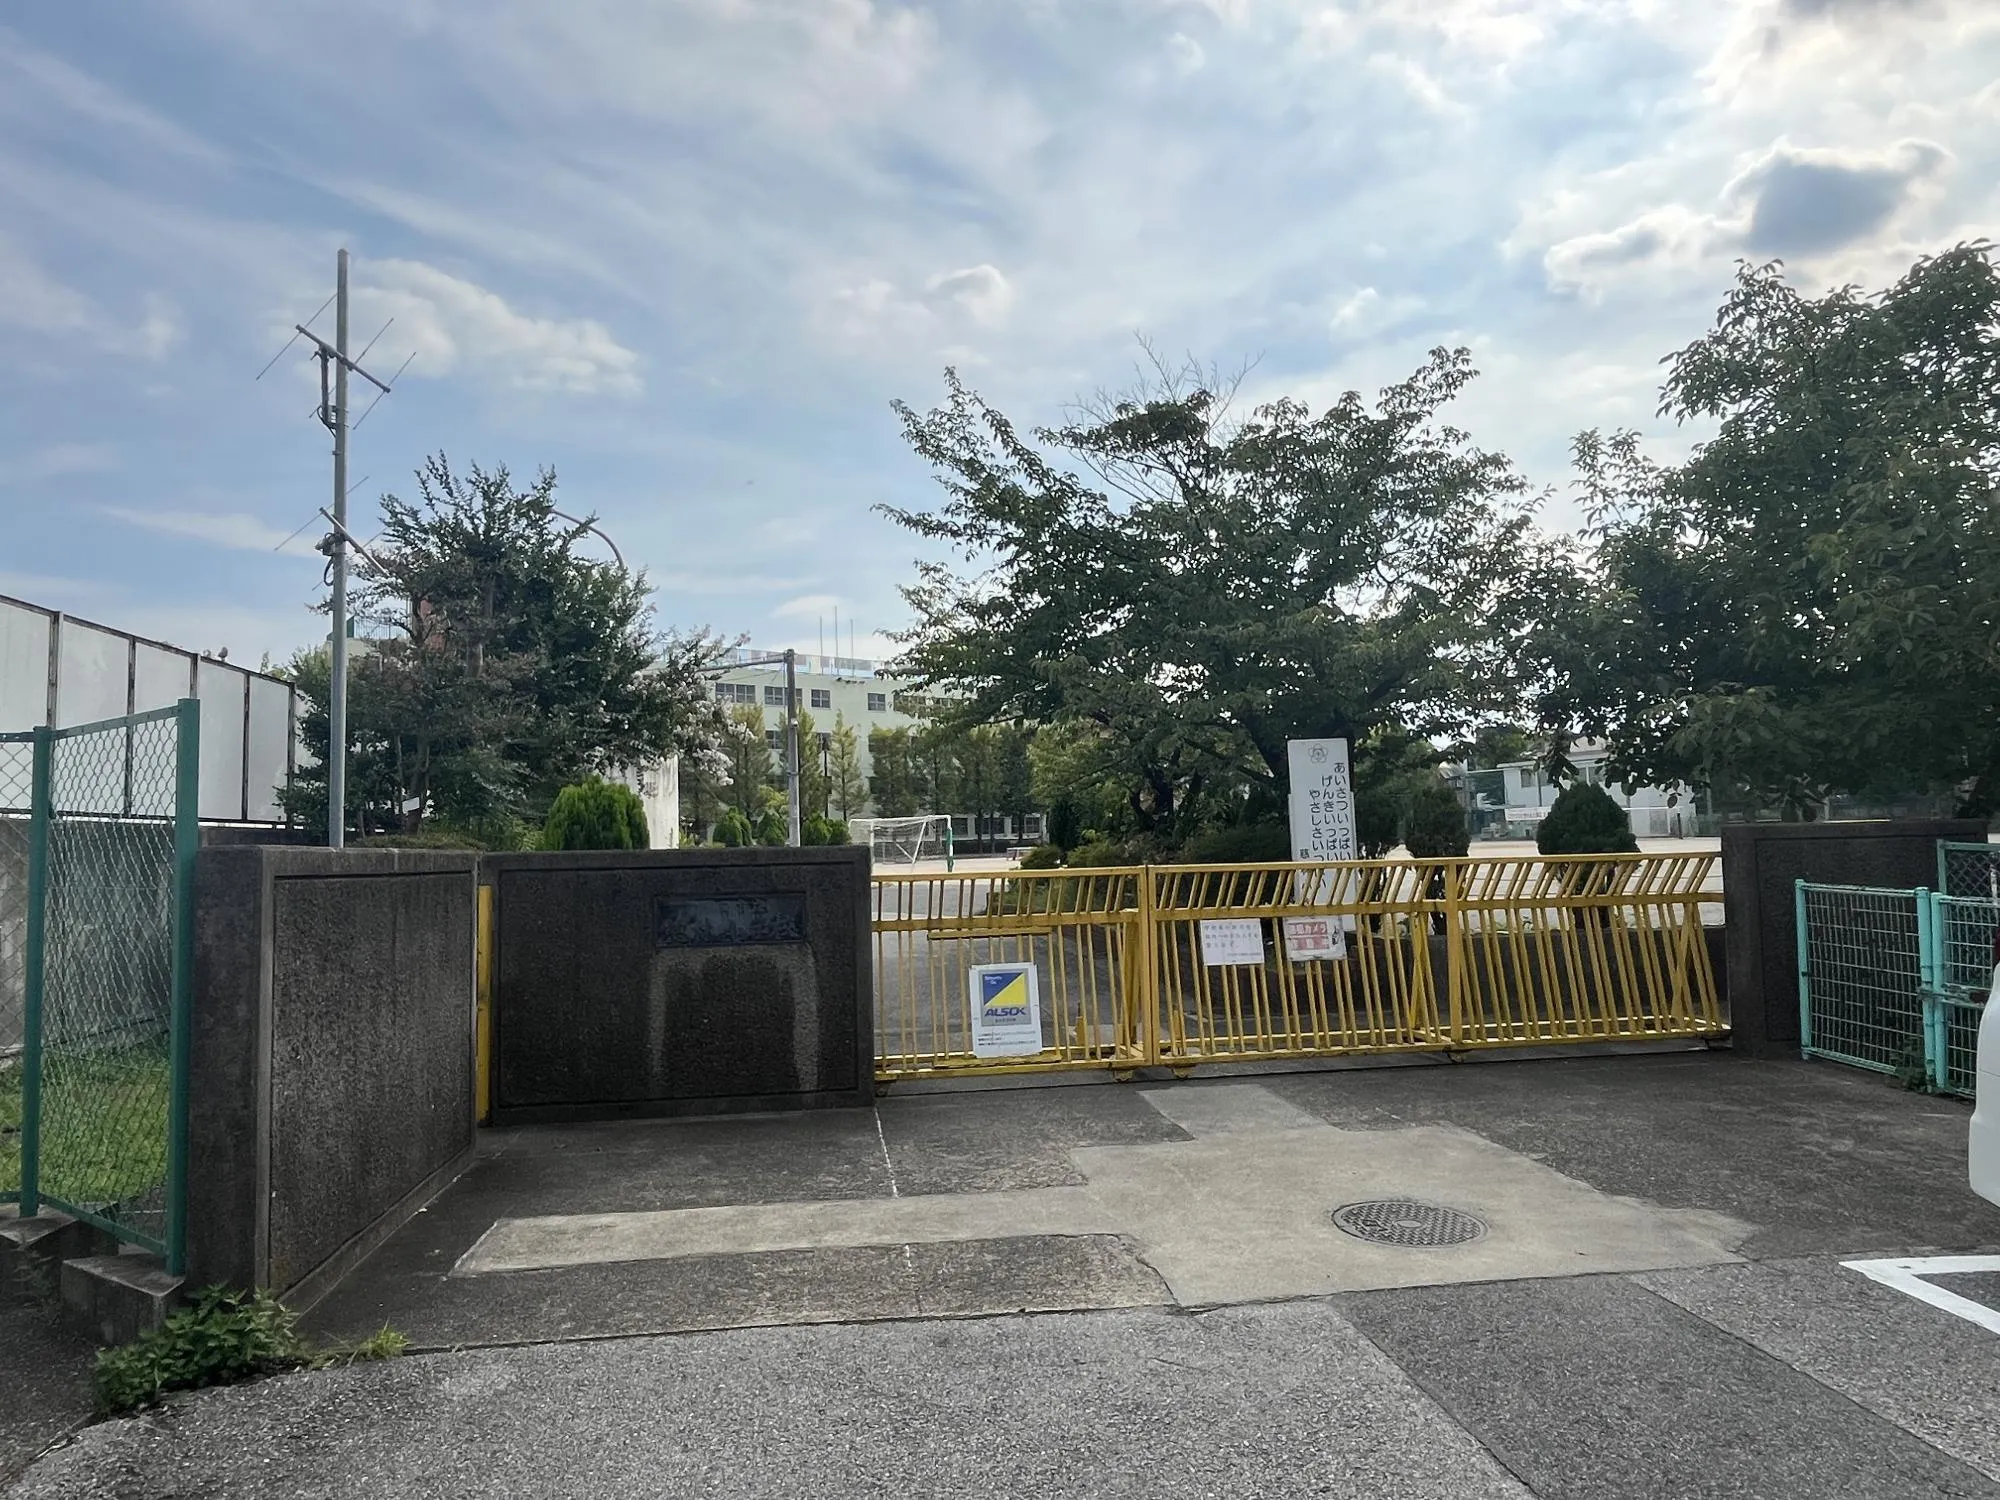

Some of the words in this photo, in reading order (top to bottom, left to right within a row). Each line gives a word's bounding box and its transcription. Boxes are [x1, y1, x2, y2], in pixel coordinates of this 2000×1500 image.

[1309, 788, 1327, 888] やさしさいっい
[1321, 775, 1339, 861] げんきいっぱい
[1334, 762, 1352, 861] あいさついっぱい
[984, 1007, 1026, 1018] ALSOK
